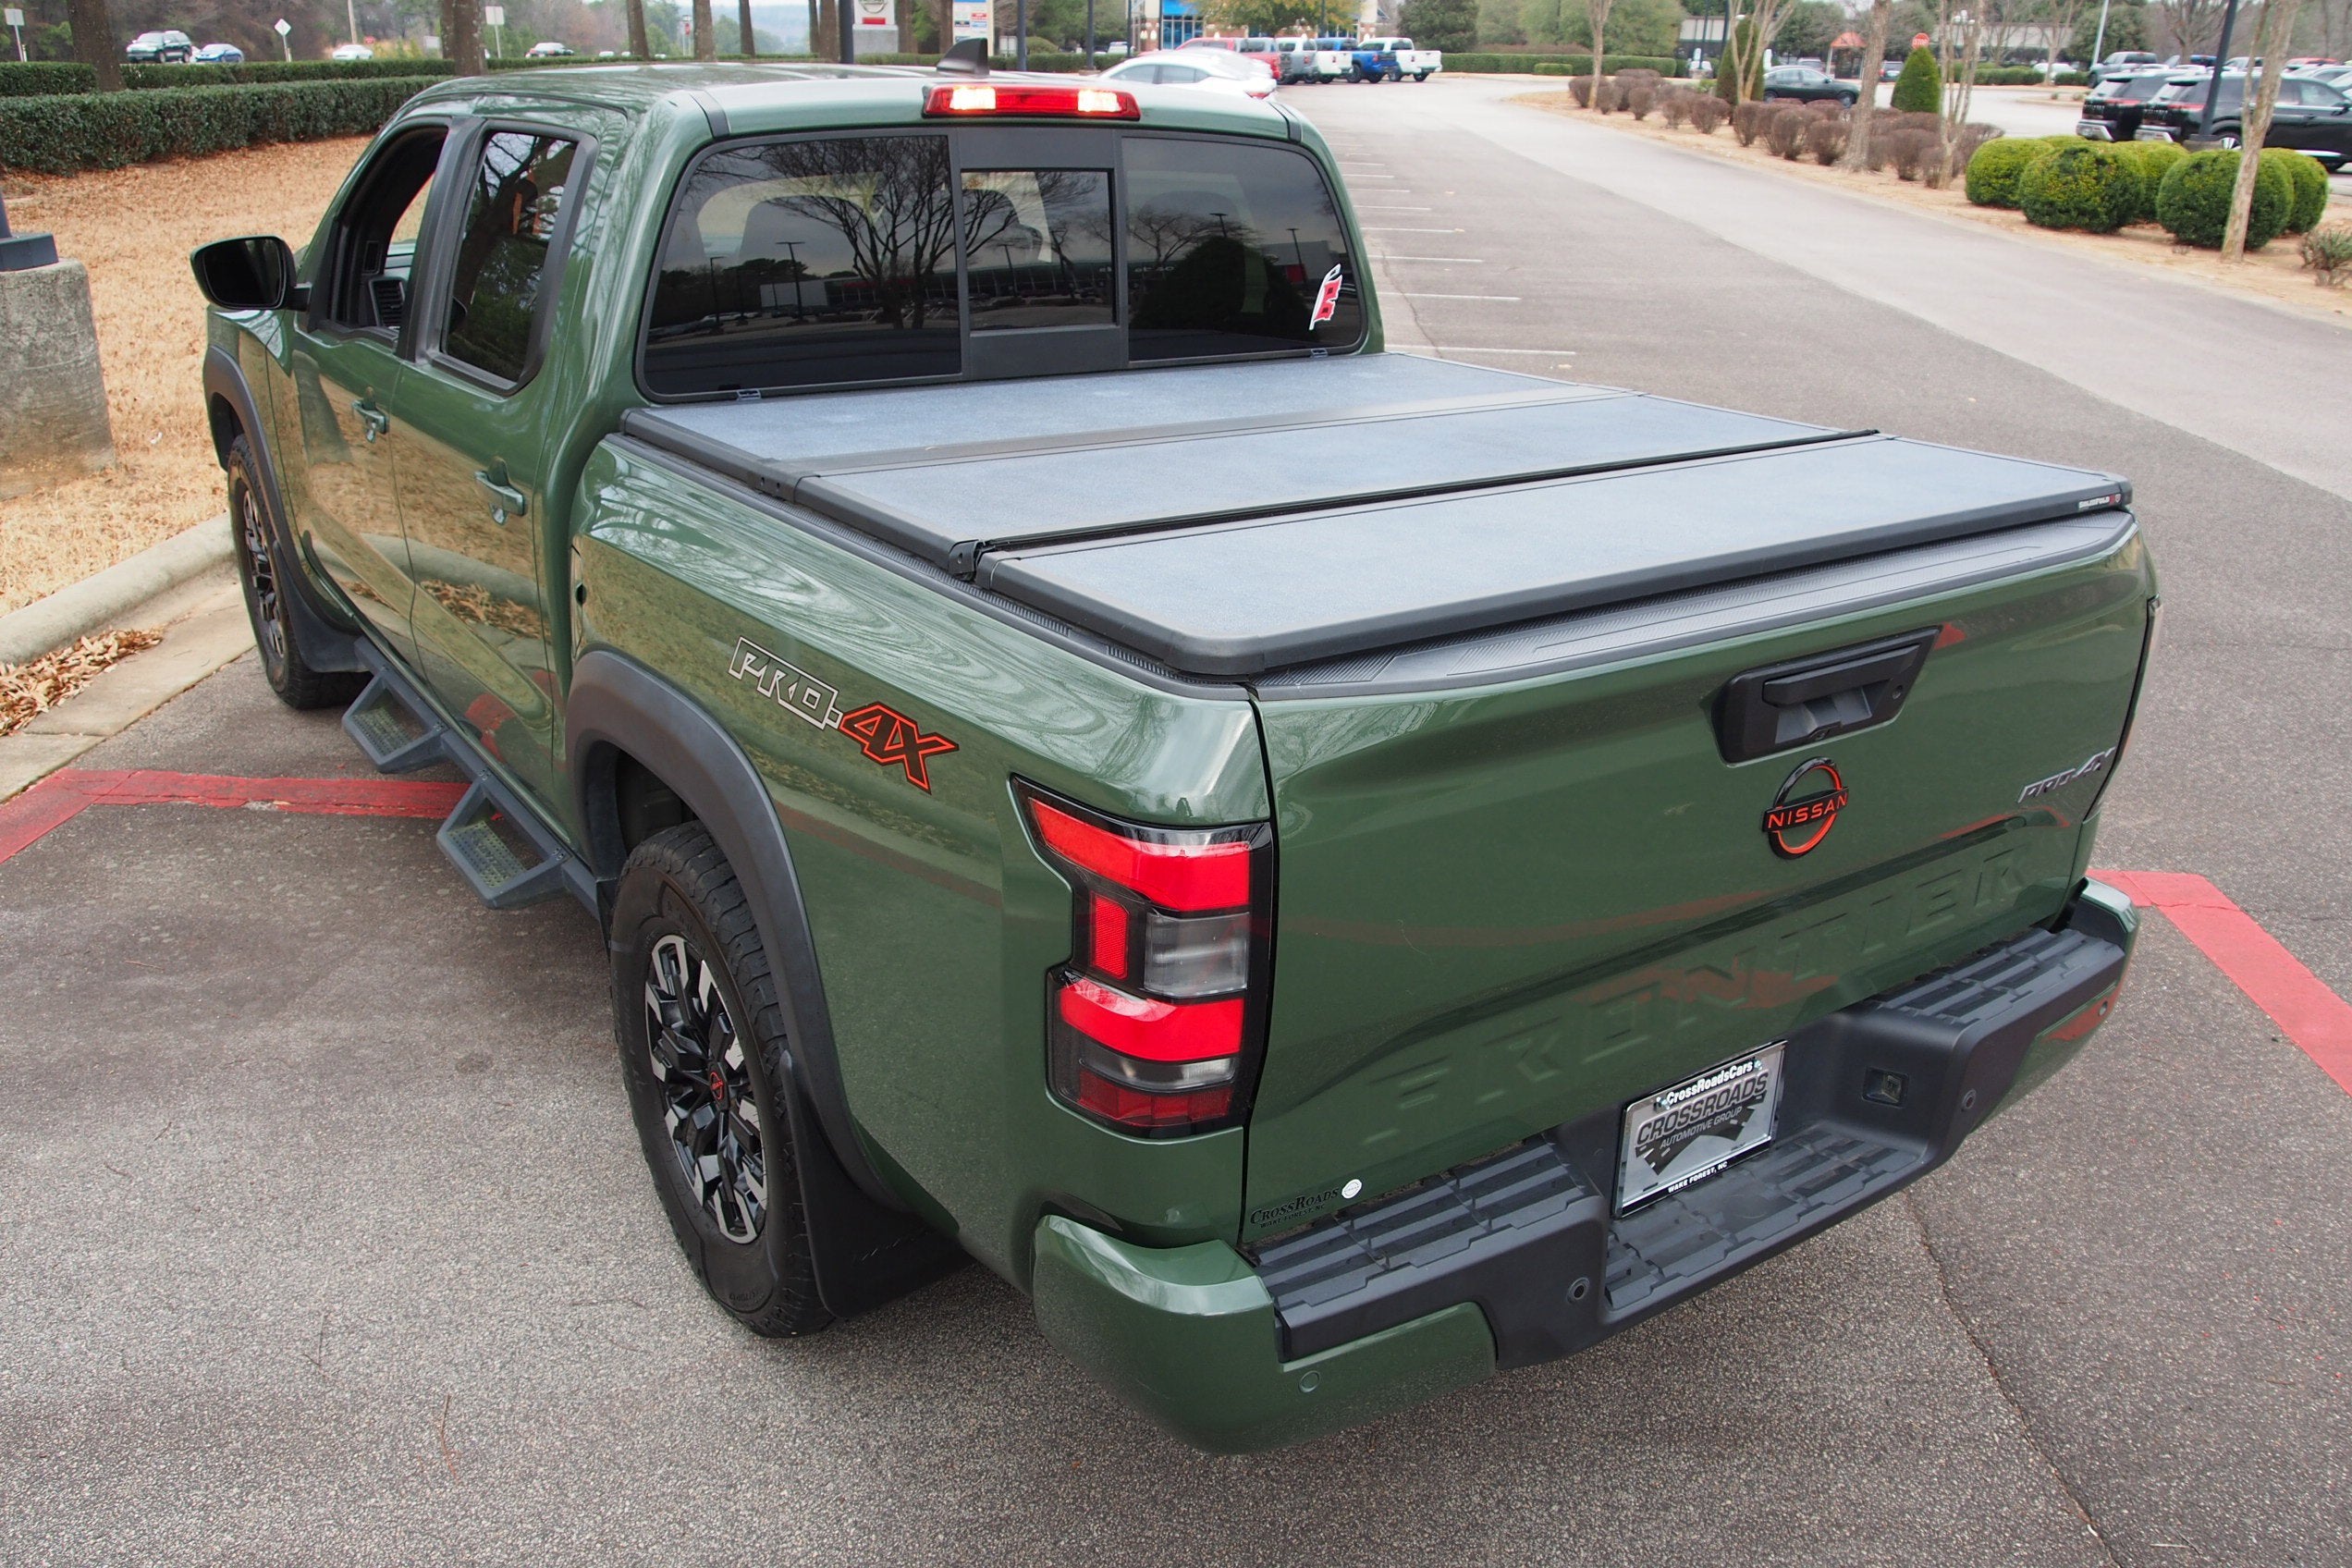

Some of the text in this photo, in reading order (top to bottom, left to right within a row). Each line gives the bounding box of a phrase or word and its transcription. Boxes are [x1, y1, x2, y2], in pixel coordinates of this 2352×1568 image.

[1768, 792, 1848, 829] NISSAN
[1355, 843, 2034, 1146] FRONTIER
[1636, 1072, 1769, 1145] CROSSROADS
[1660, 1106, 1743, 1149] AUTOMOTIVE GROUP
[1668, 1161, 1728, 1194] WAKE FOREST, NC
